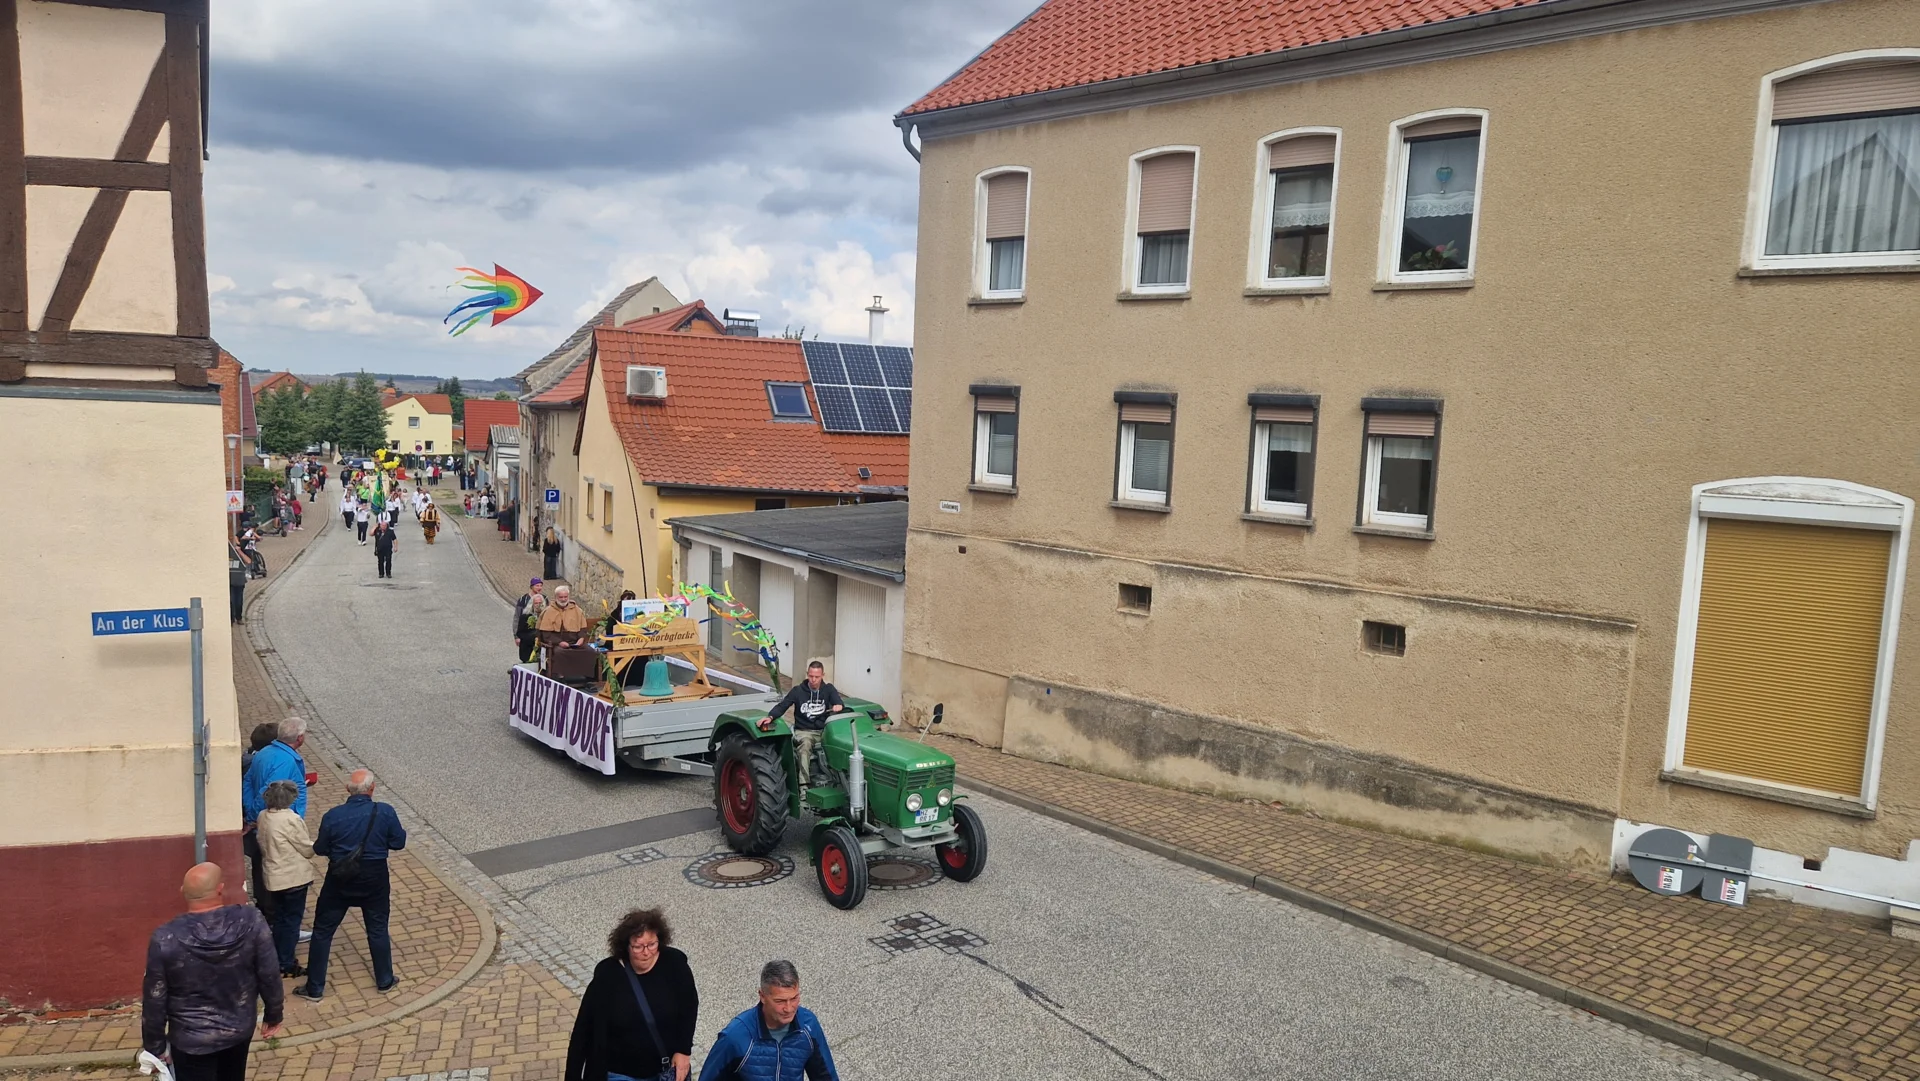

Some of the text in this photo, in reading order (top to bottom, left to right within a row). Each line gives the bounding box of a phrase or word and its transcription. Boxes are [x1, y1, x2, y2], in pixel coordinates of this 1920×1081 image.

[548, 490, 557, 501] P
[96, 613, 184, 631] An der Klus
[509, 667, 613, 762] BLEIBT IM DORF
